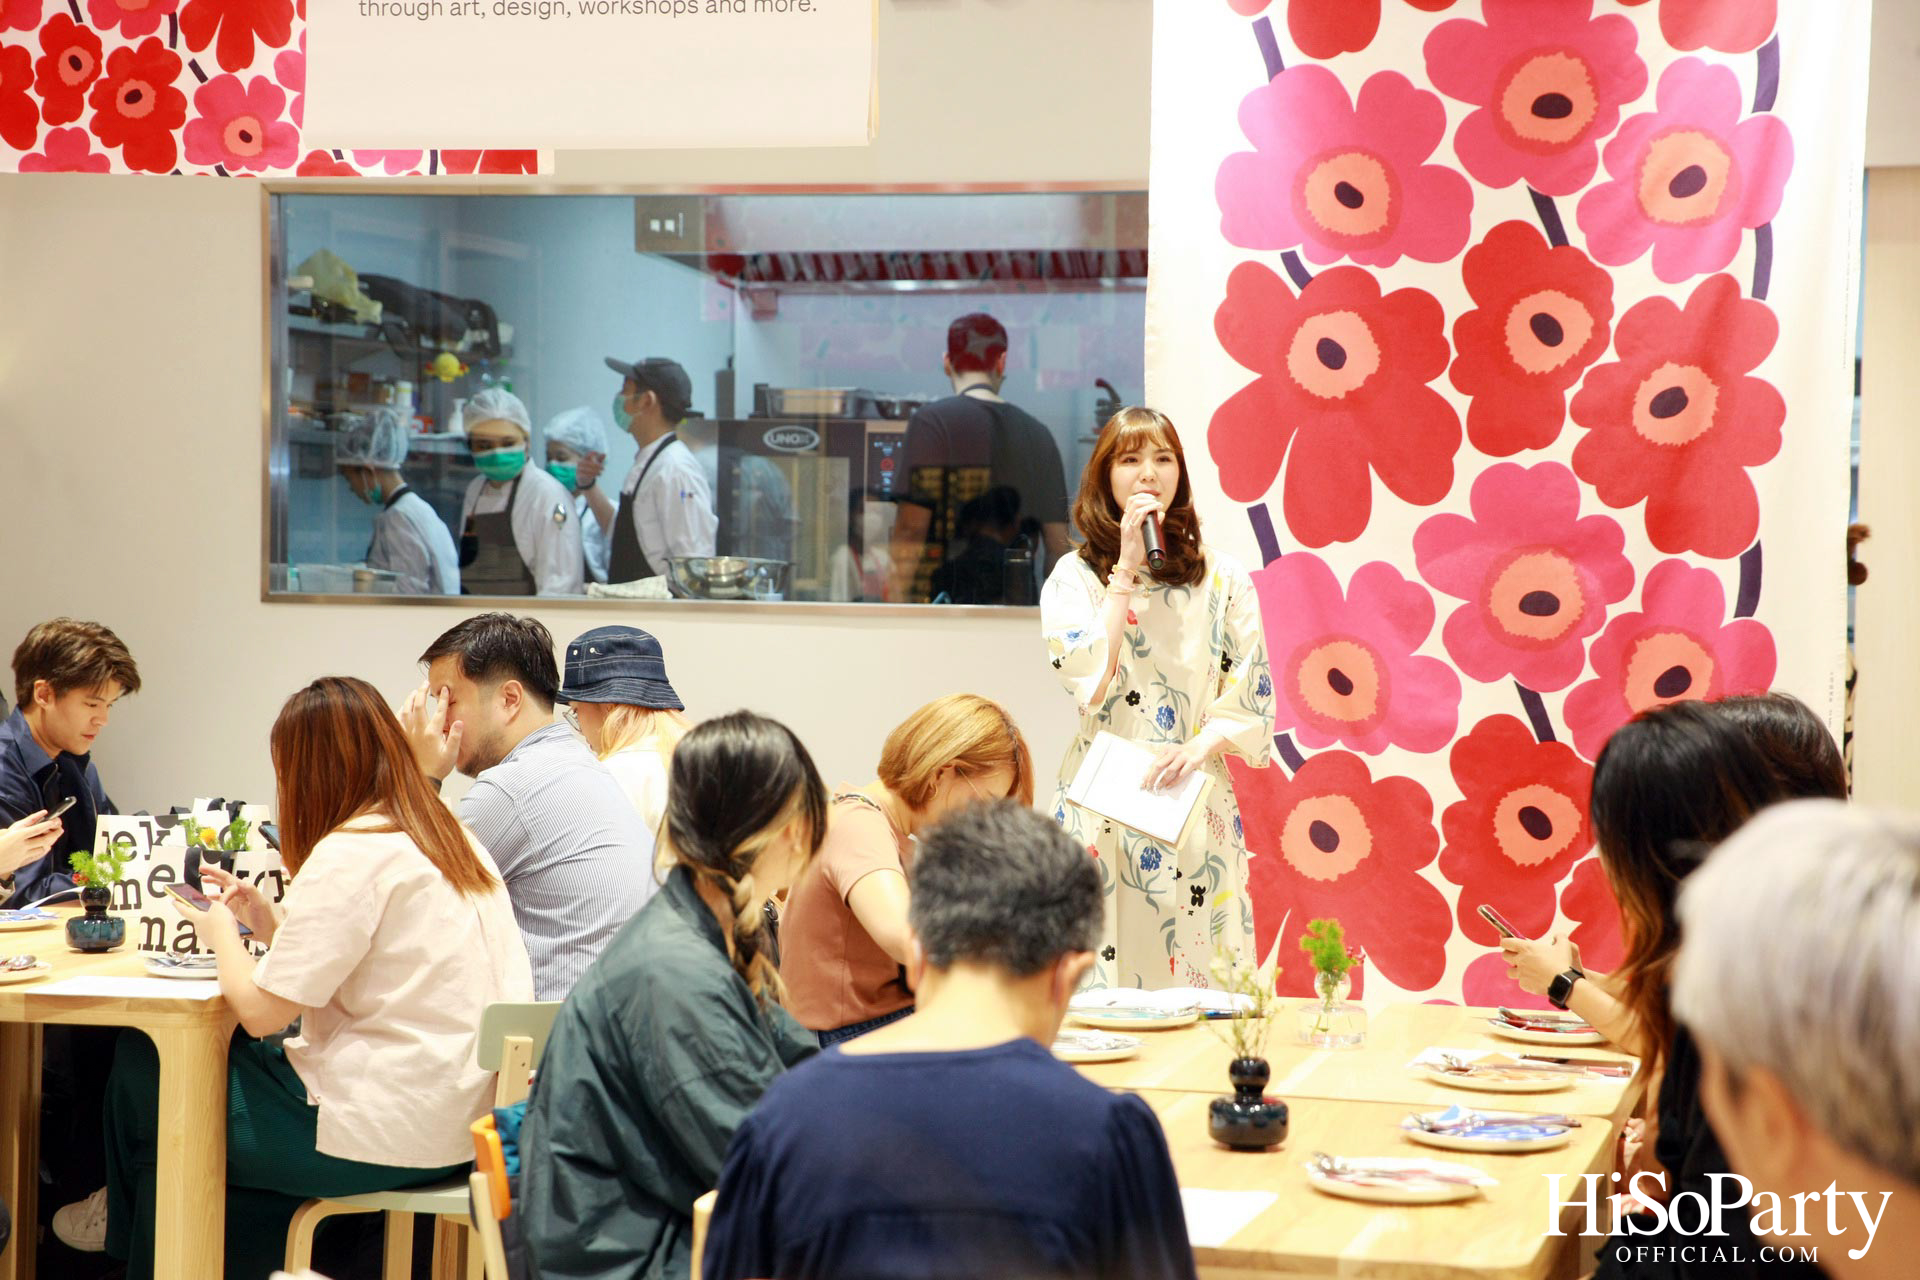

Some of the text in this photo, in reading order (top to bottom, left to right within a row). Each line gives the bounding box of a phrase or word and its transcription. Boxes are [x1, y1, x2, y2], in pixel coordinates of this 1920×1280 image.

[358, 0, 817, 21] through art, design, workshops and more.
